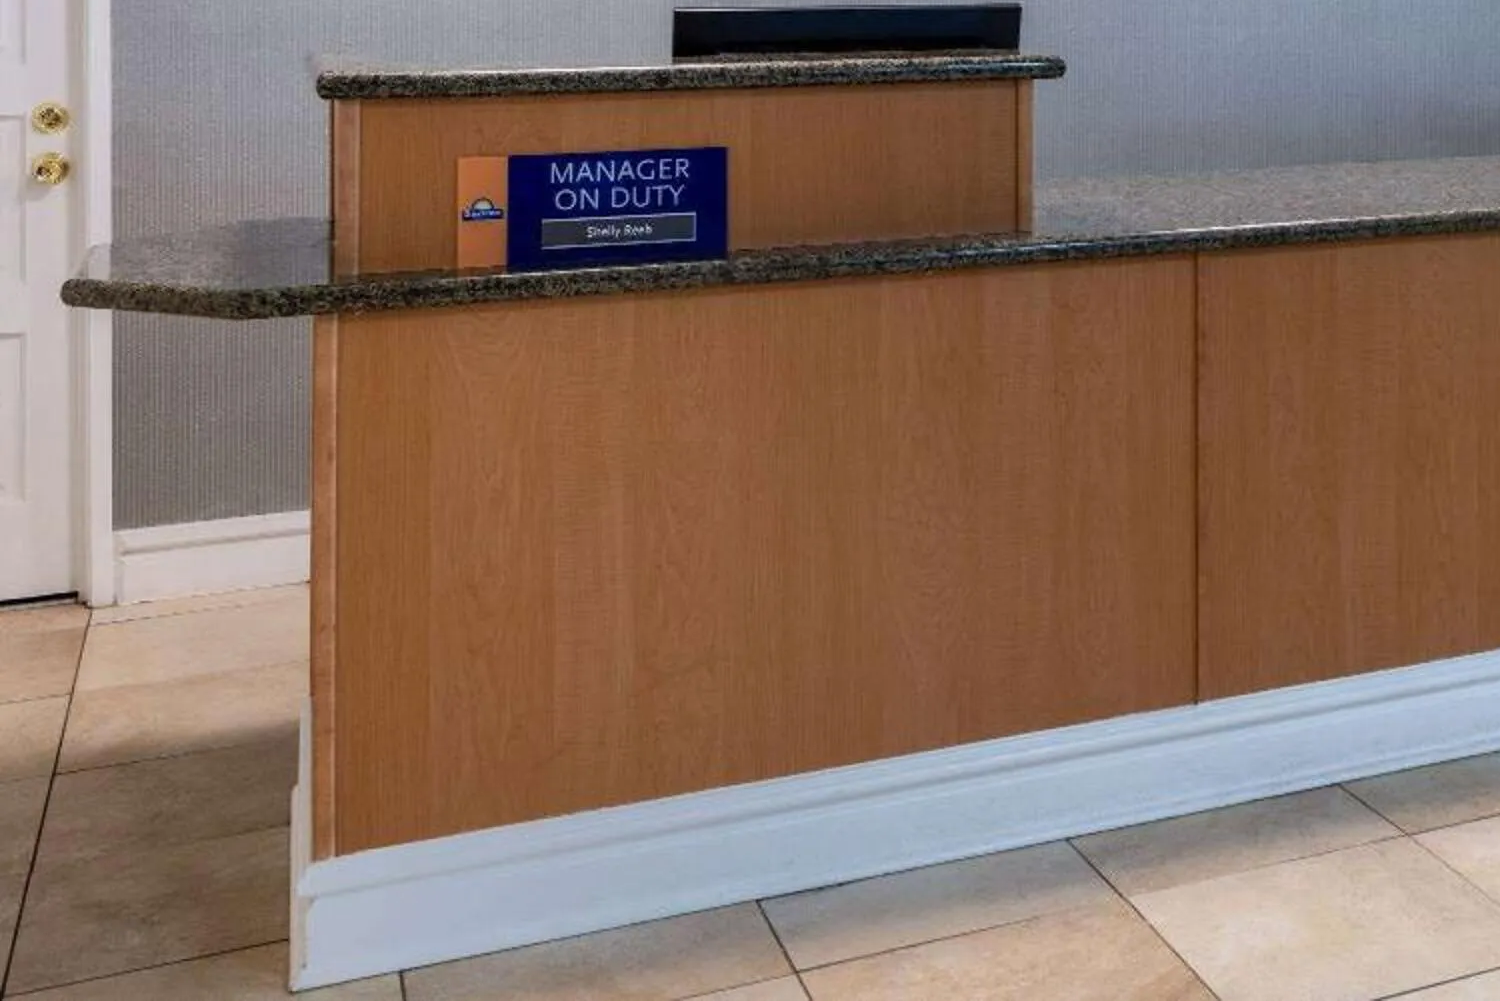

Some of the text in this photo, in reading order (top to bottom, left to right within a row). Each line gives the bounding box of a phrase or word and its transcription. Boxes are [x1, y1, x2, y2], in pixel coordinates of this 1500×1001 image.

[550, 158, 690, 184] MANAGER
[555, 184, 685, 210] ON DUTY
